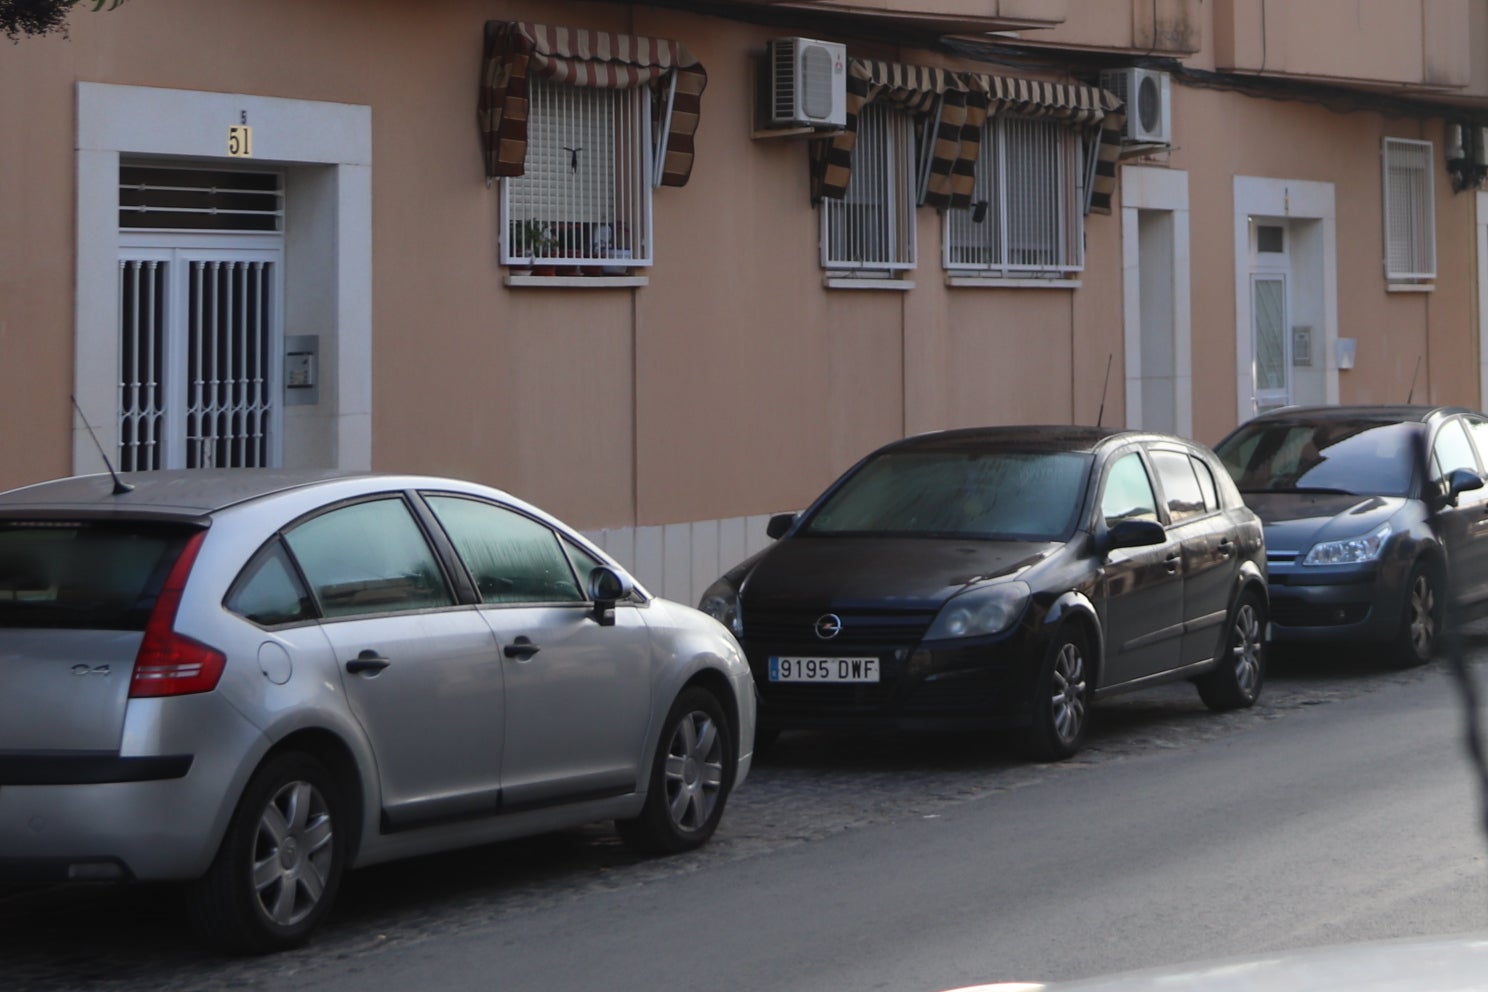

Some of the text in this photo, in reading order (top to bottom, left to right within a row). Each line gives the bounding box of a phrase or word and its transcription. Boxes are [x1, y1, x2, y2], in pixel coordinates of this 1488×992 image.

[229, 127, 249, 155] 51
[781, 659, 829, 679] 9195
[838, 659, 875, 679] DWF
